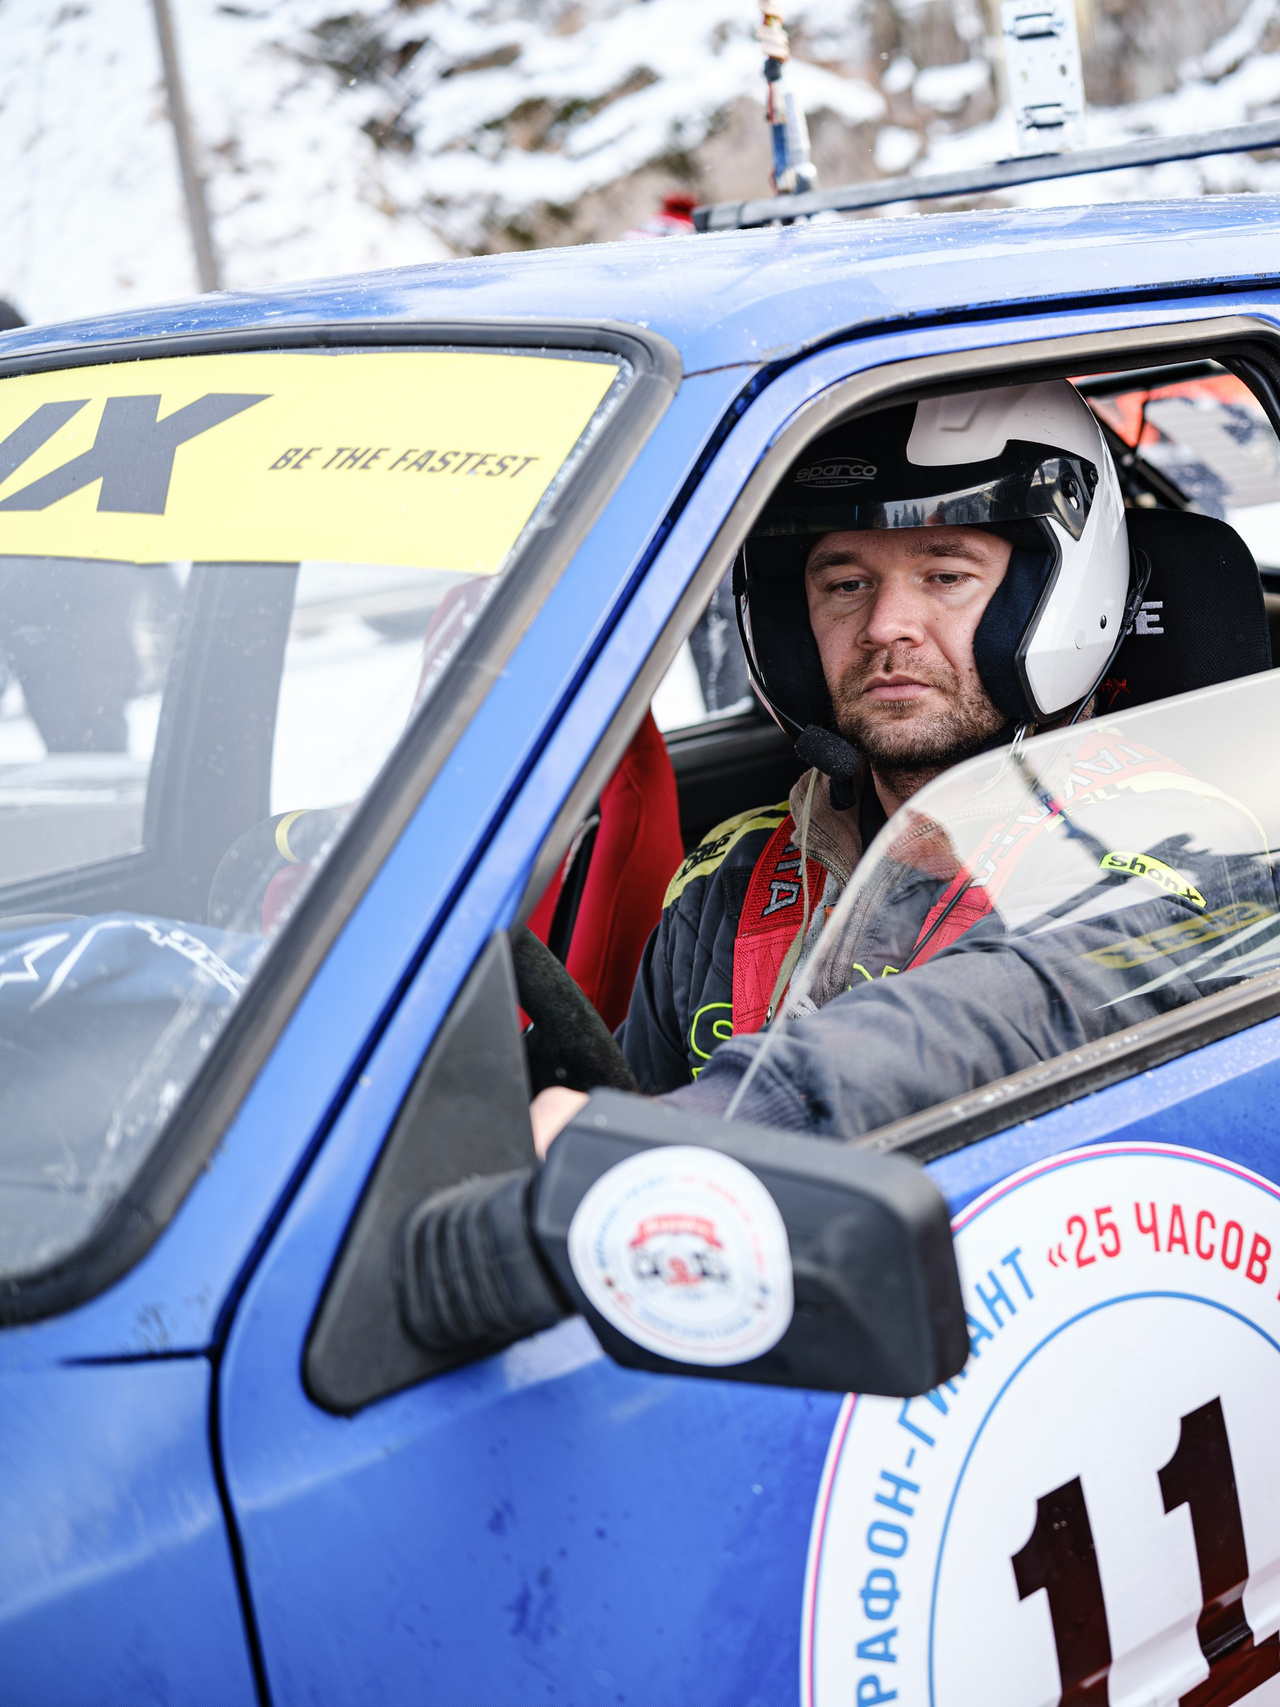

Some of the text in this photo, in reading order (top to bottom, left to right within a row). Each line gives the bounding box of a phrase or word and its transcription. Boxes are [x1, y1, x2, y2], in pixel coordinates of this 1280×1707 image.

[268, 447, 540, 478] BE THE FASTEST
[796, 464, 877, 482] sparco
[1046, 1205, 1122, 1269] «25
[1134, 1201, 1272, 1285] ЧАСОВ
